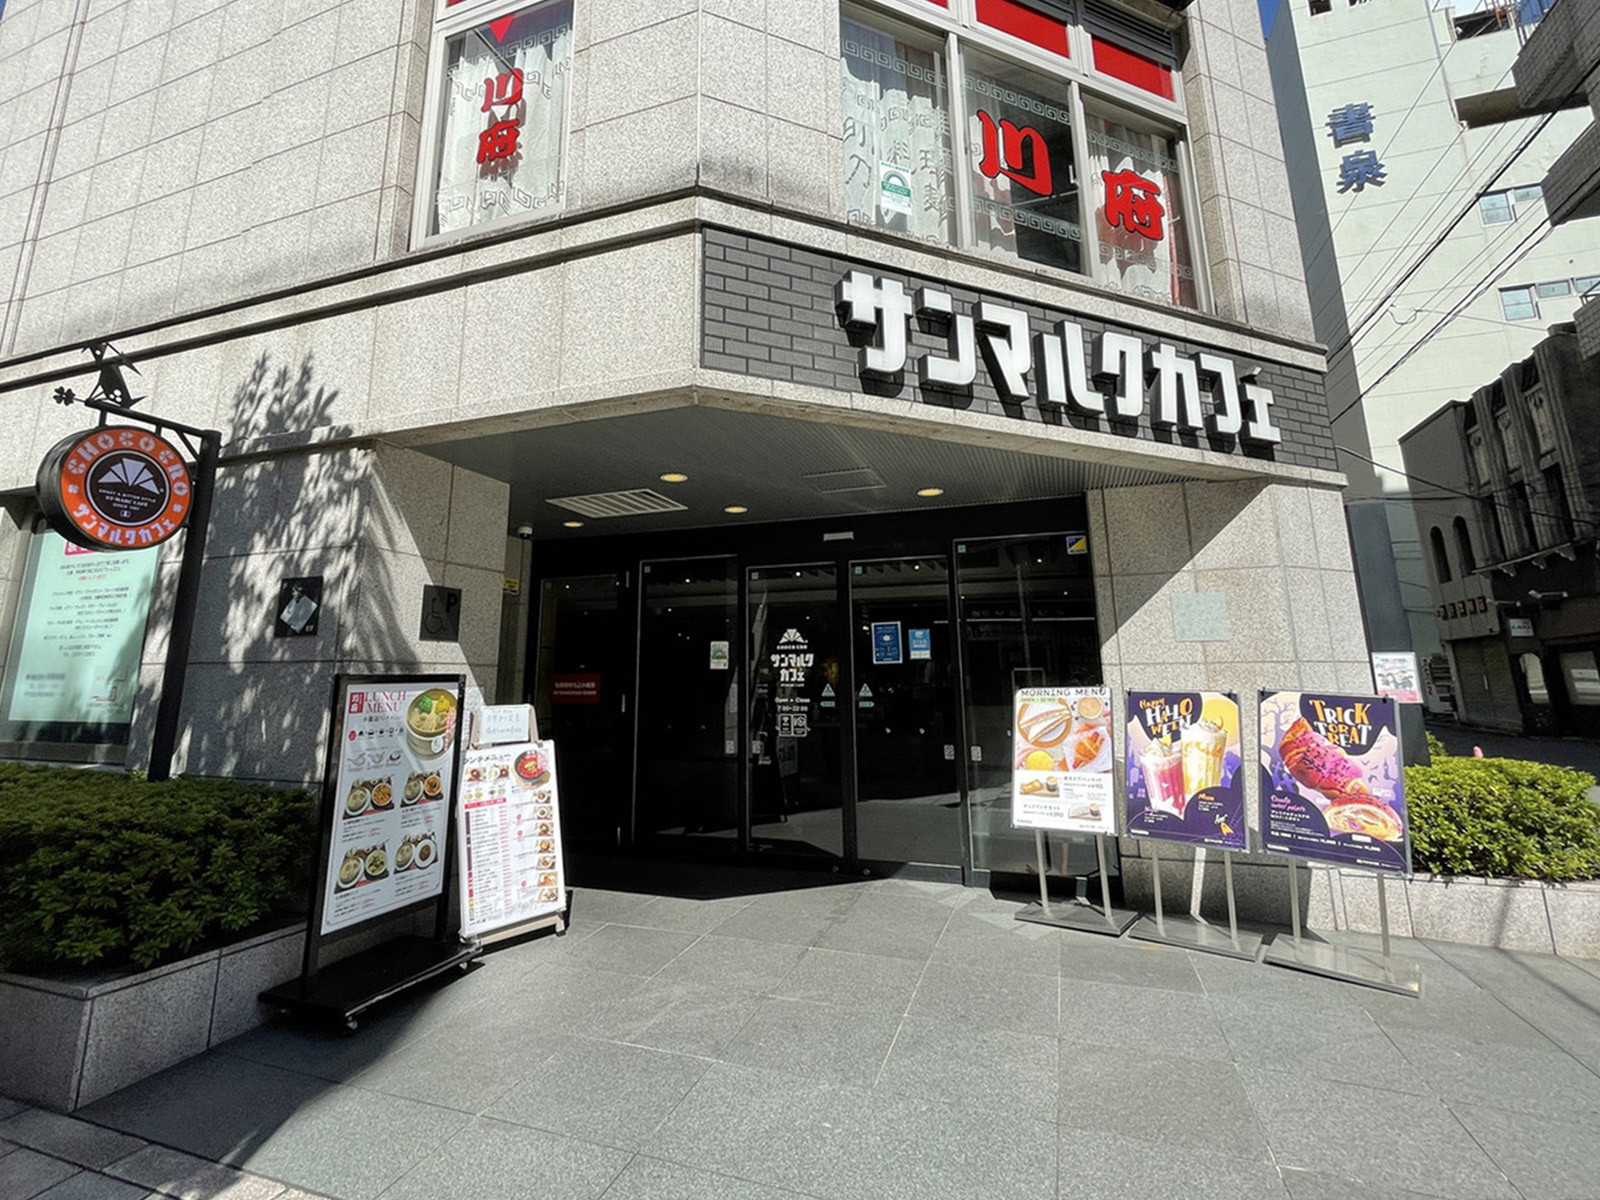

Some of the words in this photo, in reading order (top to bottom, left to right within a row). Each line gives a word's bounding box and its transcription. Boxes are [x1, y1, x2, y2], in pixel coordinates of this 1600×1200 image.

[1325, 101, 1388, 191] 書泉
[837, 270, 1283, 445] サンマルクカフェ
[67, 432, 156, 475] CHOCO
[158, 450, 189, 496] CRO
[73, 504, 174, 543] サンマルクカフェ
[446, 592, 458, 613] P
[770, 653, 815, 668] サンマルク
[779, 668, 806, 683] カフェ
[365, 690, 407, 703] LUNCH
[1020, 688, 1071, 697] MORNING
[1075, 688, 1107, 697] MENU
[367, 702, 401, 714] MENU
[1139, 697, 1166, 710] Happy
[1309, 699, 1372, 726] TRICK
